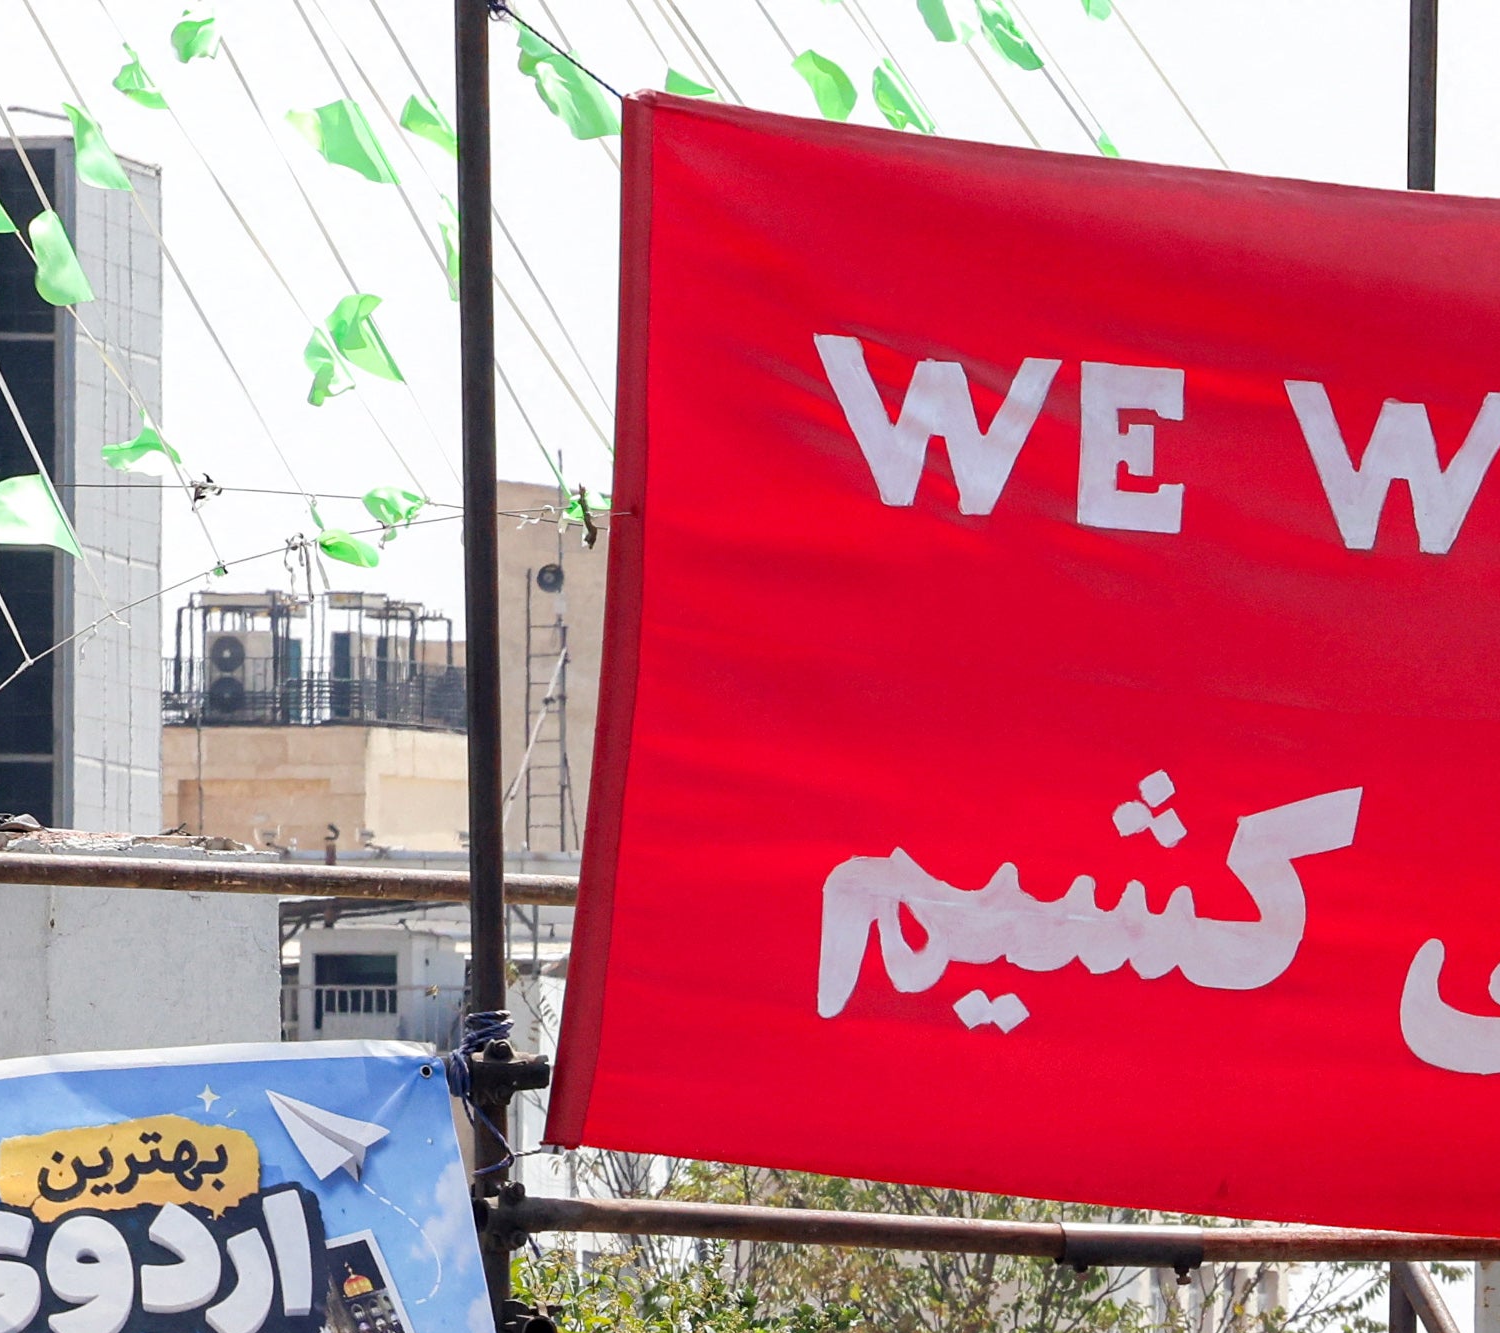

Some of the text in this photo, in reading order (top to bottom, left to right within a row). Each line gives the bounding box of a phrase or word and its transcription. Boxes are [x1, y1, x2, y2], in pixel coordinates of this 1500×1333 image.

[812, 332, 1186, 535] WE
[816, 768, 1364, 1035] کشیم
[37, 1131, 230, 1202] بهترین
